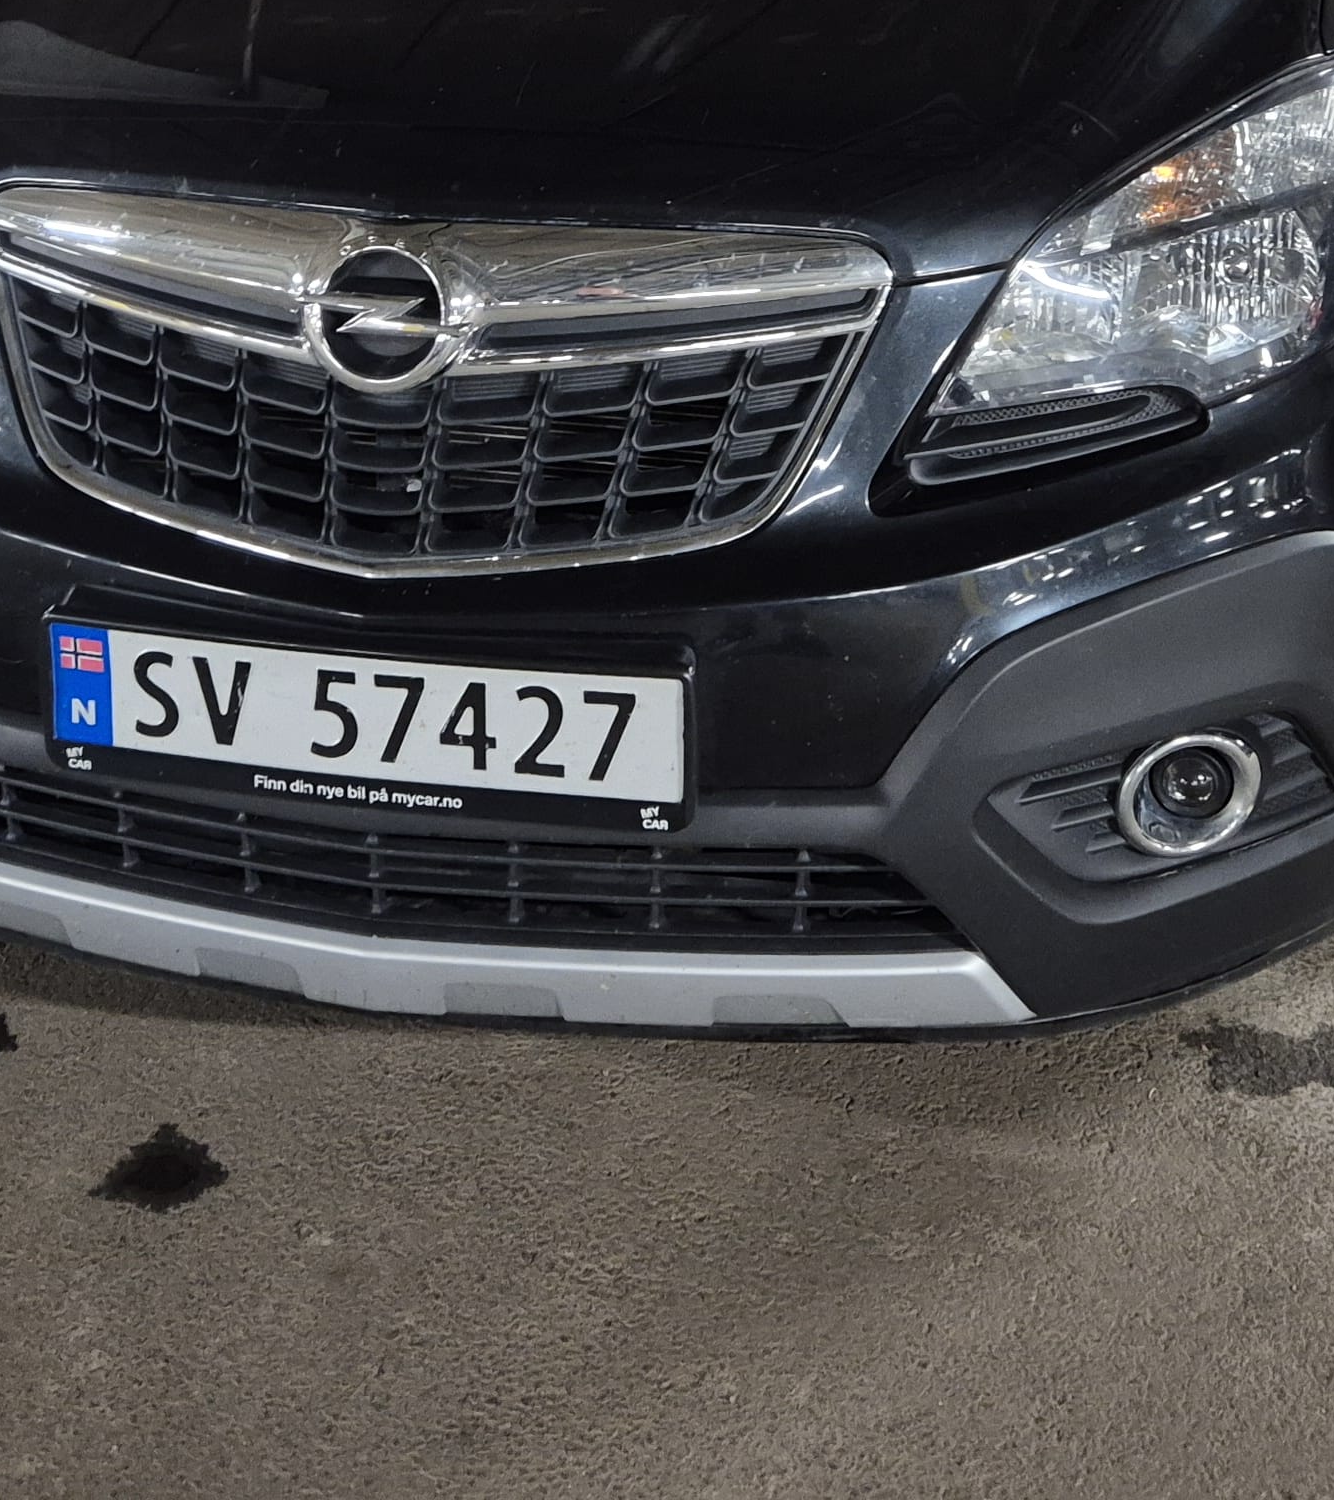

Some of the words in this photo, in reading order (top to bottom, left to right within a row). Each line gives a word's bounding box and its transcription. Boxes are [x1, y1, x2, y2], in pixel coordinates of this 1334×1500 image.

[71, 698, 96, 726] N
[133, 651, 252, 746] SV
[310, 668, 638, 782] 57427
[68, 758, 92, 771] CAR
[253, 774, 287, 792] Finn
[289, 779, 314, 795] din
[317, 784, 344, 800] nye
[347, 784, 367, 800] bil
[369, 787, 389, 804] på
[391, 791, 463, 810] mycar.no
[640, 806, 660, 819] MY
[642, 819, 669, 831] CAR
